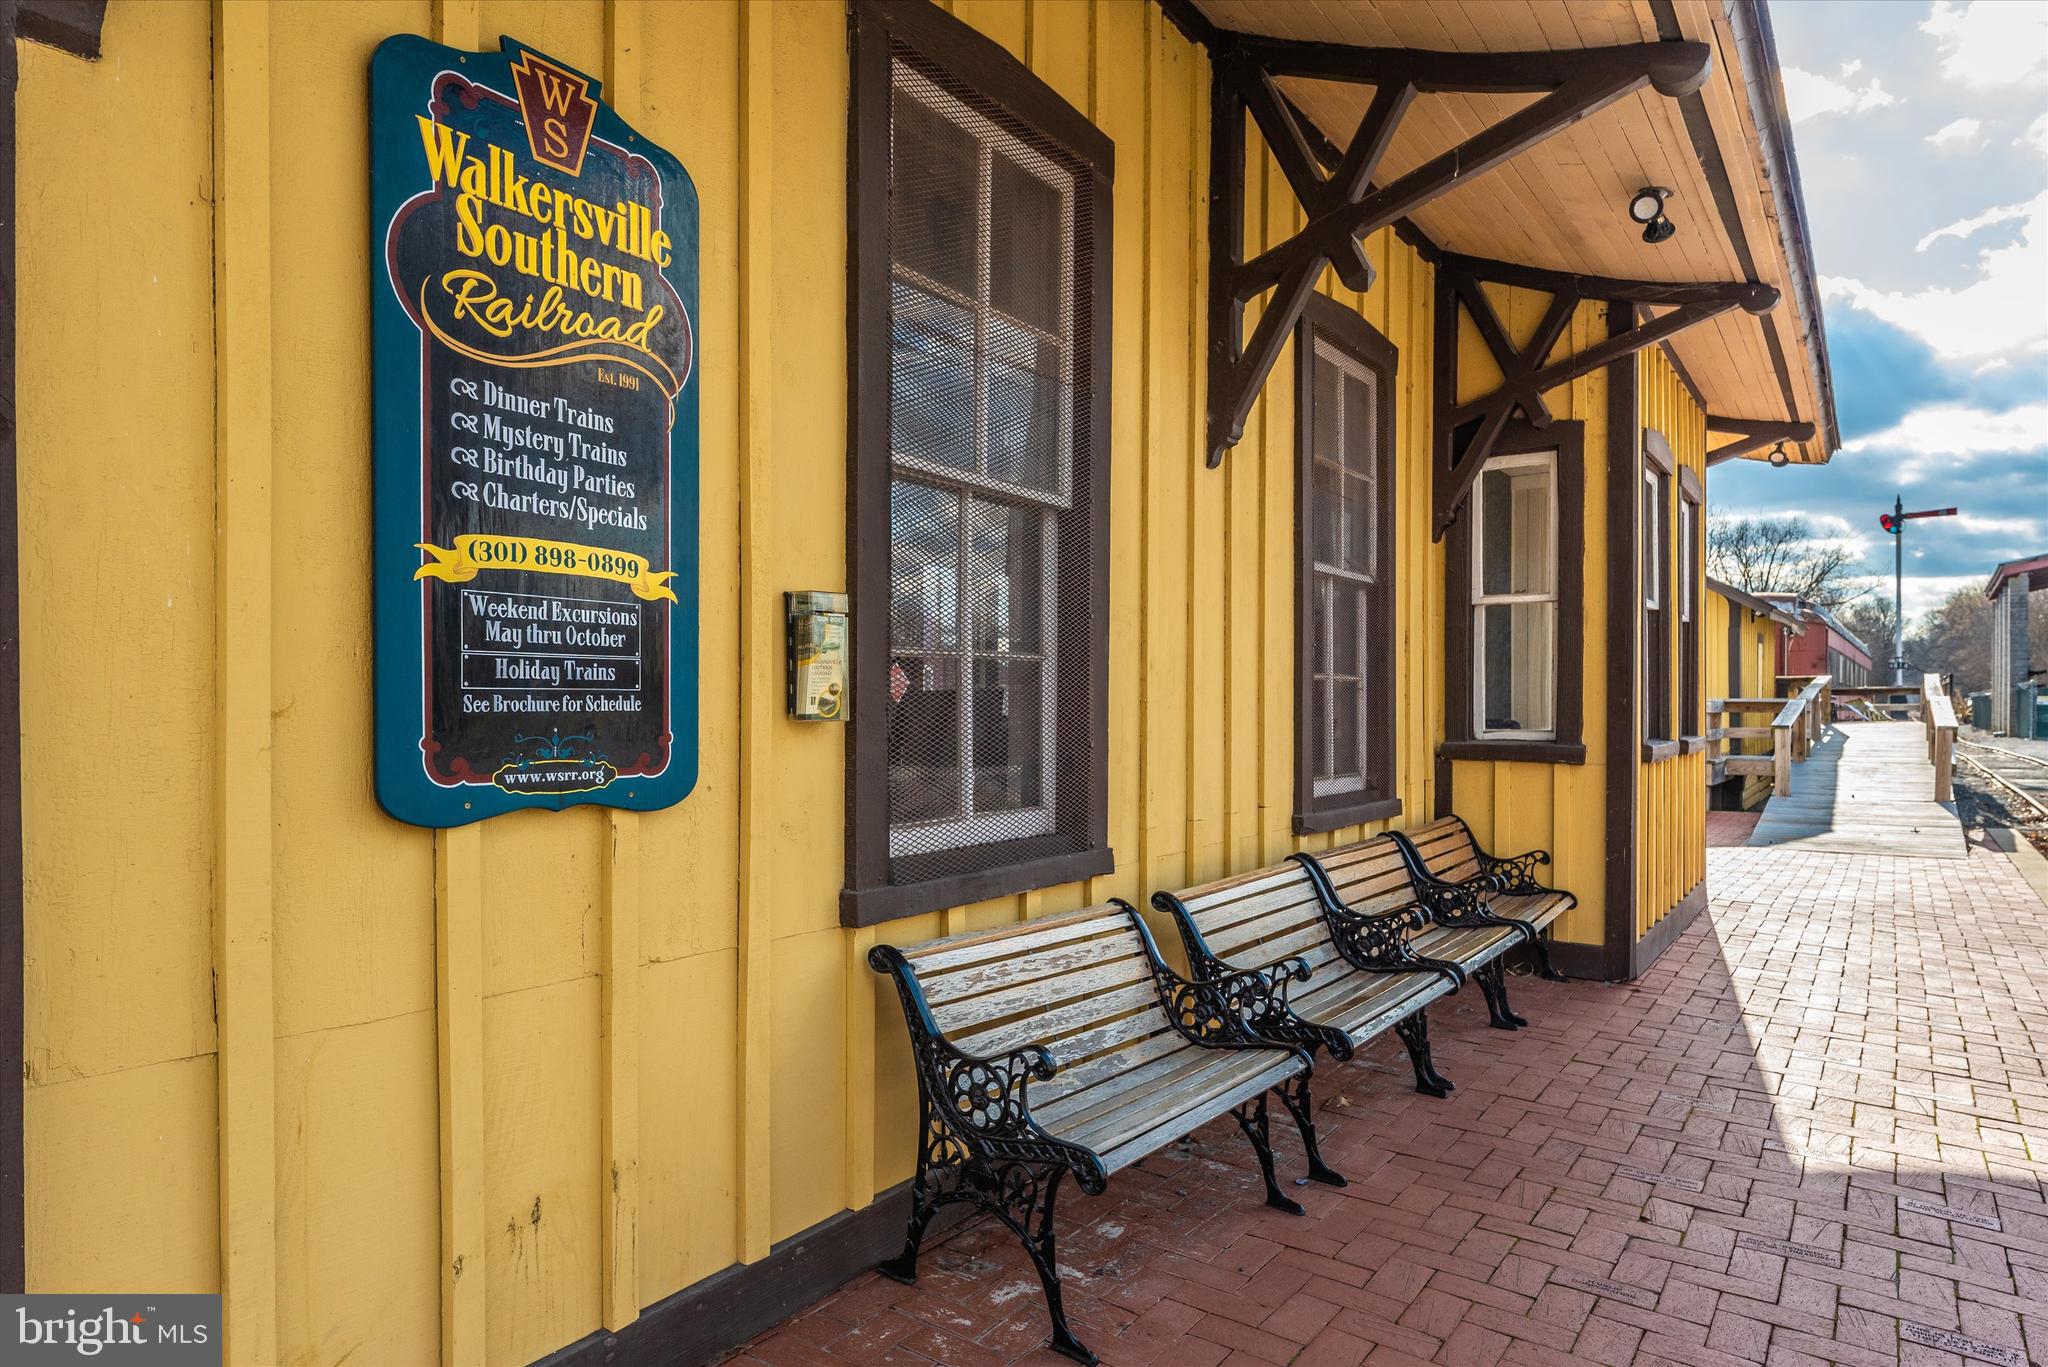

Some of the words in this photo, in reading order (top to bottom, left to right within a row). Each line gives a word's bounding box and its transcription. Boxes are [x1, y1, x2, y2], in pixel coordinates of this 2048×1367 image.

[535, 67, 575, 117] W
[544, 118, 569, 159] S
[415, 114, 673, 268] Walkersville
[456, 192, 645, 313] Southern
[442, 269, 664, 354] Railroad
[598, 368, 617, 386] Est.
[619, 374, 640, 391] 1991
[483, 379, 550, 419] Dinner
[554, 397, 615, 434] Trains
[483, 413, 564, 461] Mystery
[568, 432, 627, 467] Trains
[483, 447, 568, 493] Birthday
[573, 464, 635, 499] Parties
[483, 481, 648, 531] Charters/Specials
[468, 539, 528, 564] (301)
[534, 545, 639, 578] 898-0899
[469, 594, 548, 621] Weekend
[552, 601, 637, 626] Excursions
[485, 620, 522, 649] May
[526, 624, 562, 645] thru
[566, 625, 626, 647] October
[495, 658, 560, 685] Holiday
[564, 660, 616, 681] Trains
[463, 694, 490, 713] See
[493, 694, 560, 713] Brochure
[562, 695, 583, 712] for
[585, 694, 642, 713] Schedule
[504, 765, 605, 784] www.wsrr.org
